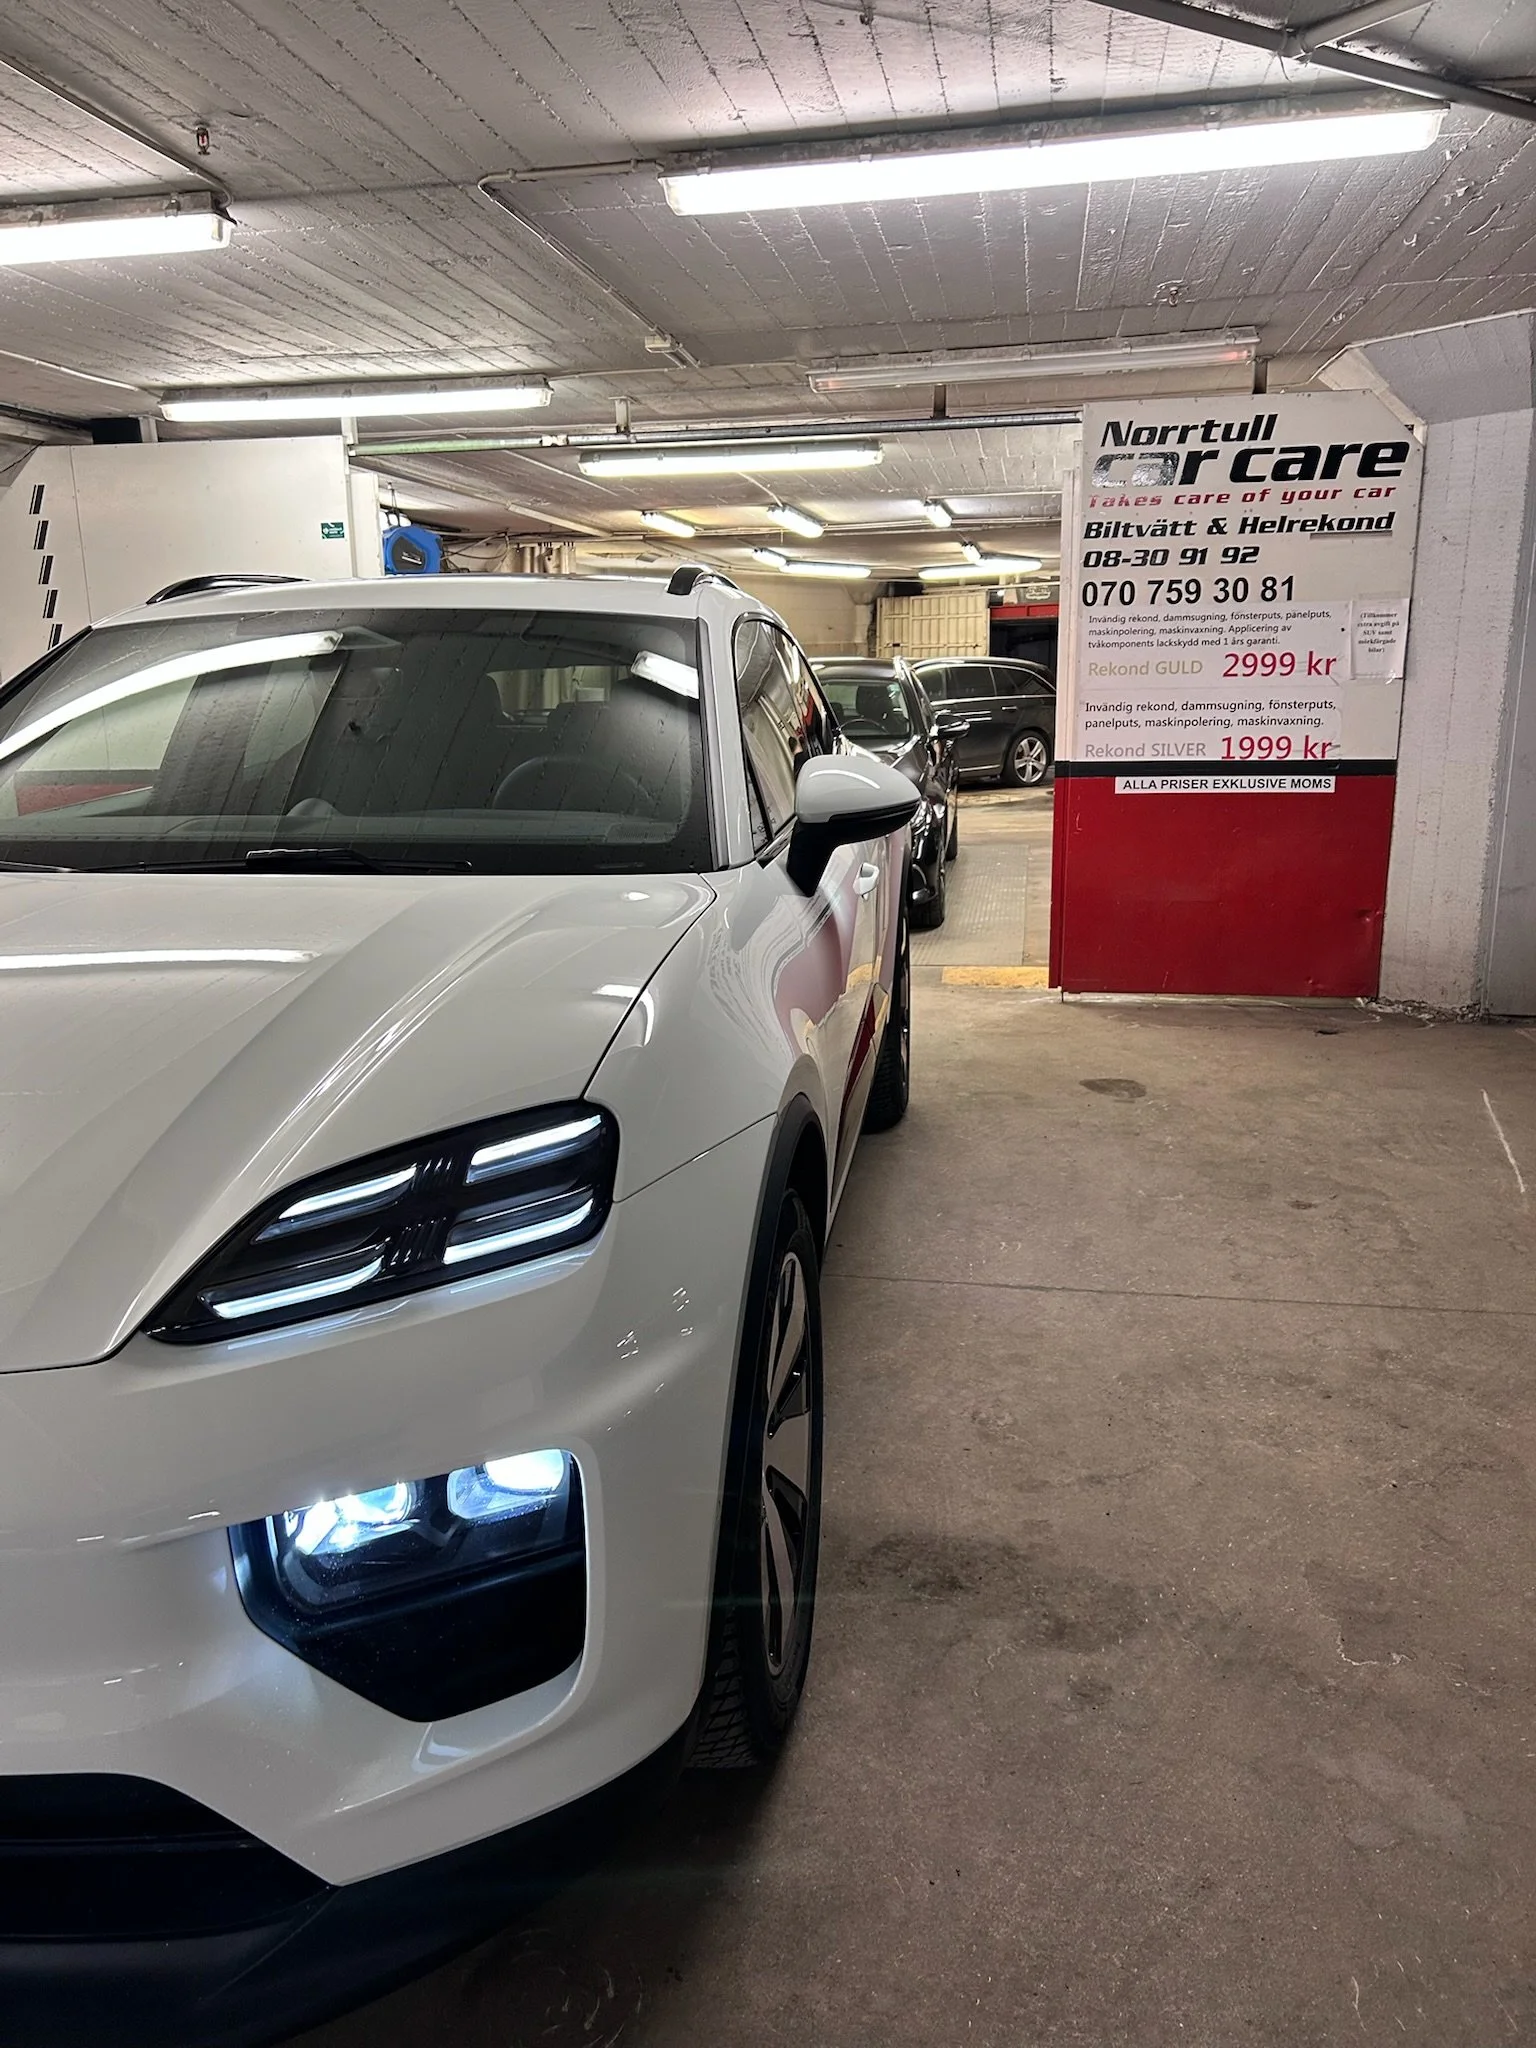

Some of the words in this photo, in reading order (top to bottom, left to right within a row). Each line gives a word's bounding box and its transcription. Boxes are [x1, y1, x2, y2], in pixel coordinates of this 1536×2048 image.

[1100, 414, 1278, 447] Norrtull
[1091, 449, 1220, 488] car
[1229, 442, 1410, 483] care
[1088, 494, 1163, 508] Takes
[1174, 492, 1231, 505] care
[1241, 488, 1271, 503] of
[1280, 488, 1343, 504] your
[1353, 487, 1396, 499] car
[1083, 519, 1197, 539] Biltvätt
[1207, 517, 1228, 535] &
[1238, 511, 1396, 534] Helrekond
[1083, 549, 1170, 568] 08-30
[1178, 547, 1209, 566] 91
[1220, 546, 1260, 564] 92
[1082, 580, 1136, 607] 070
[1147, 578, 1201, 605] 759
[1213, 577, 1249, 603] 30
[1260, 575, 1294, 602] 81
[1088, 614, 1126, 625] Invändig
[1128, 614, 1160, 623] rekond,
[1162, 612, 1228, 624] dammsugning,
[1230, 610, 1283, 623] fönsterputs,
[1088, 626, 1157, 637] maskinpolering,
[1228, 623, 1279, 635] Applicering
[1281, 624, 1293, 632] av
[1088, 638, 1155, 650] tvåkomponents
[1156, 637, 1199, 649] lackskydd
[1201, 636, 1221, 646] med
[1223, 637, 1229, 646] 1
[1231, 635, 1245, 646] års
[1246, 635, 1281, 648] garanti.
[1088, 661, 1150, 677] Rekond
[1155, 660, 1204, 676] GULD
[1222, 652, 1297, 678] 2999
[1307, 650, 1337, 676] kr
[1085, 702, 1133, 714] Invändig
[1136, 701, 1178, 713] rekond,
[1181, 700, 1265, 713] dammsugning,
[1268, 699, 1337, 712] fönsterputs,
[1085, 718, 1142, 731] panelputs,
[1144, 716, 1234, 730] maskinpolering,
[1085, 743, 1146, 758] Rekond
[1151, 742, 1207, 757] SILVER
[1220, 735, 1293, 760] 1999
[1303, 734, 1333, 759] kr
[1122, 779, 1158, 790] ALLA
[1160, 779, 1209, 790] PRISER
[1212, 778, 1287, 789] EXKLUSIVE
[1290, 778, 1332, 789] MOMS
